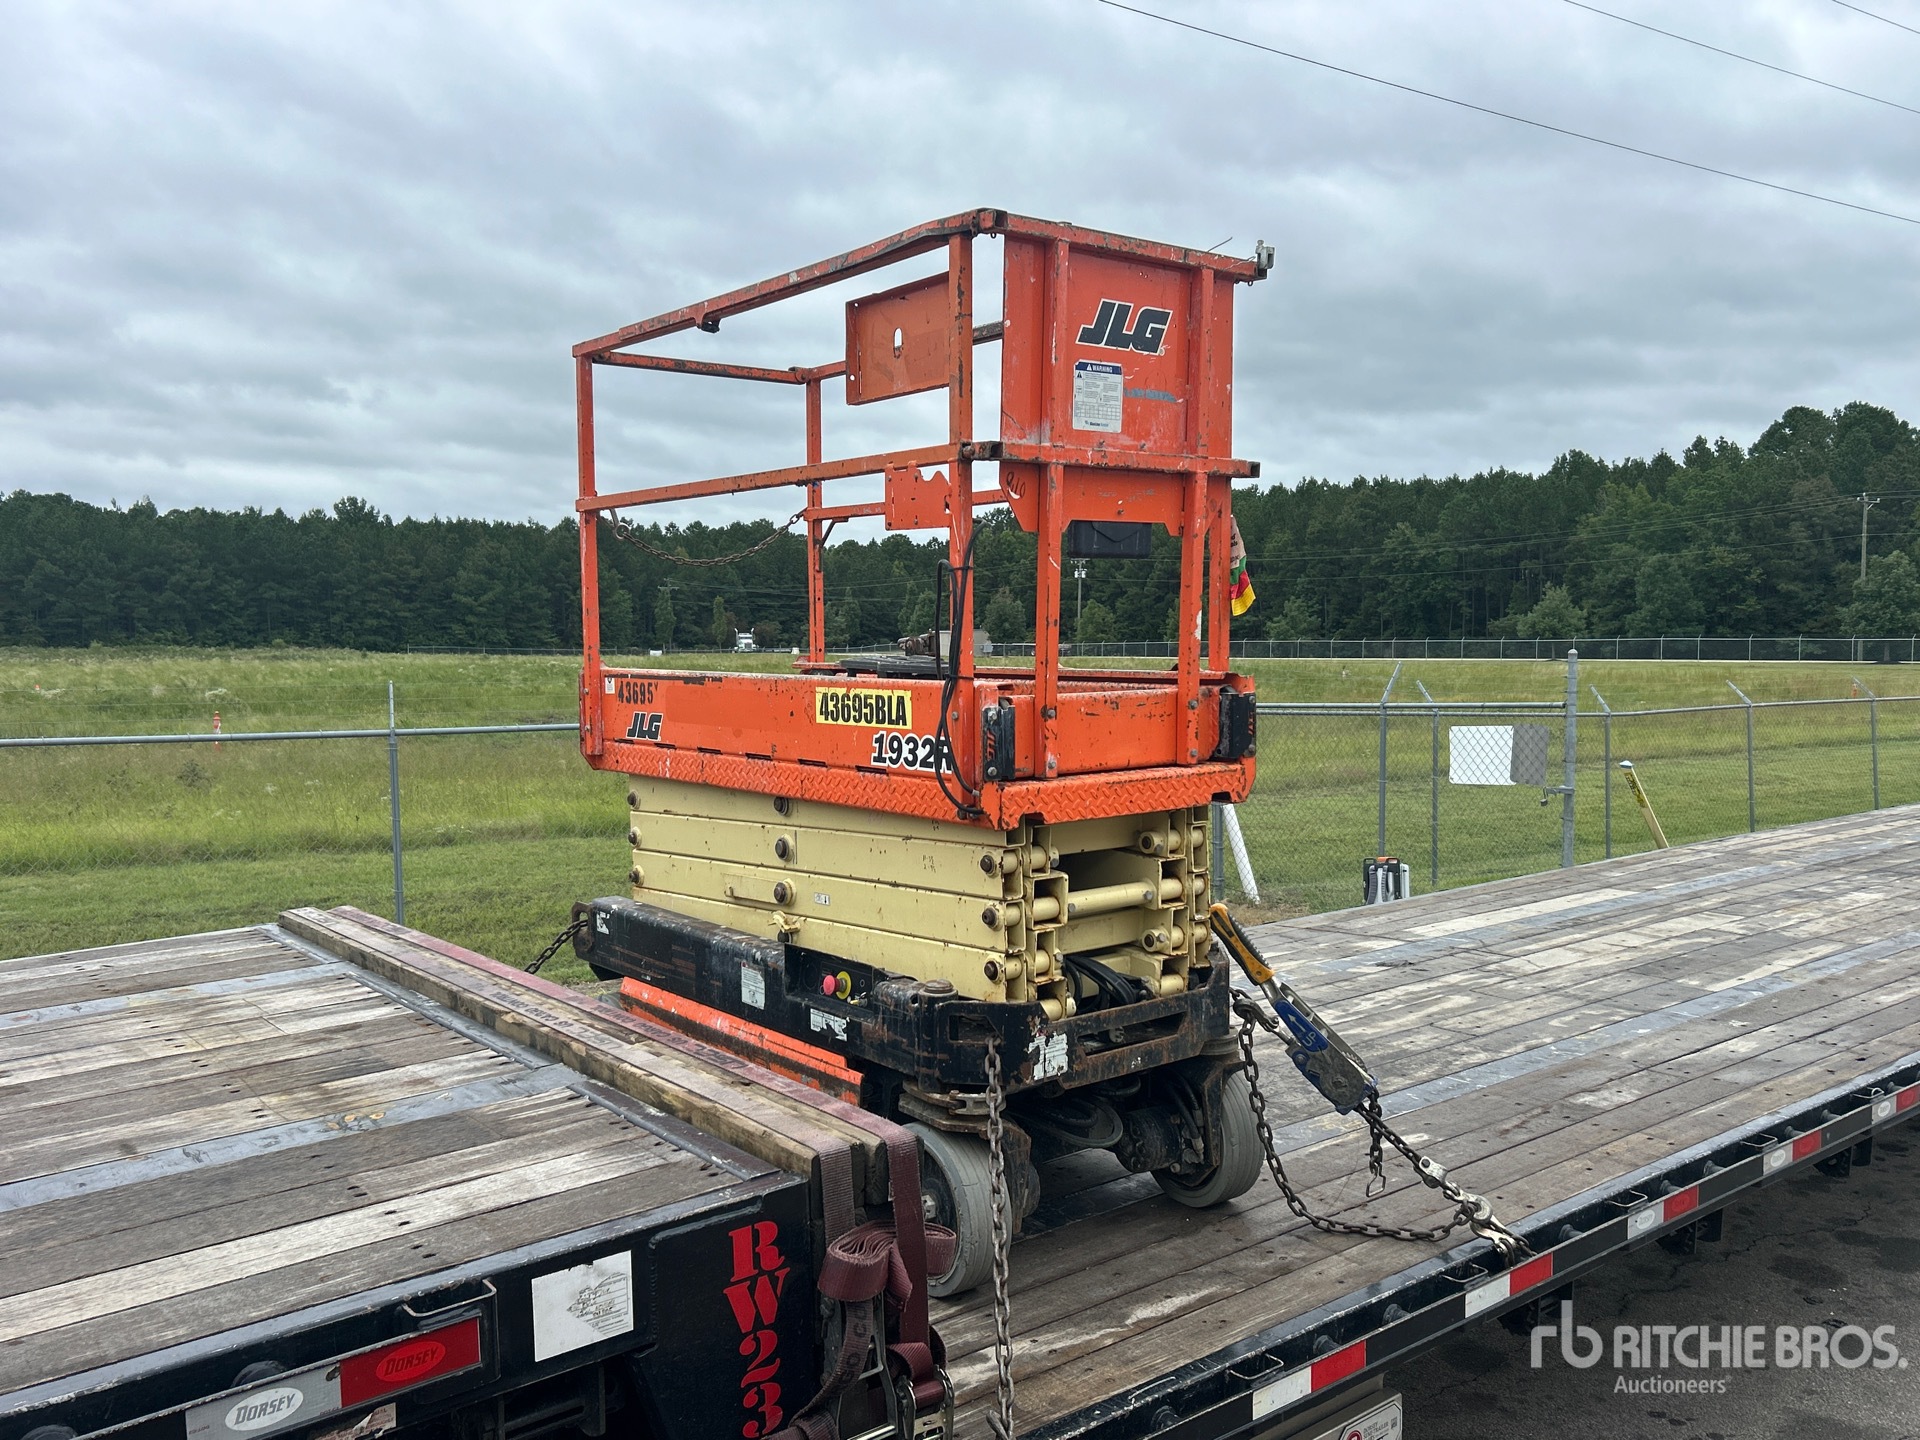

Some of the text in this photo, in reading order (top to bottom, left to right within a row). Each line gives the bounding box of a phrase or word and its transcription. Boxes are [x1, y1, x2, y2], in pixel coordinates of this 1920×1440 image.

[1075, 298, 1173, 355] JLG
[819, 692, 908, 727] 43695BLA
[626, 711, 664, 742] JLG
[1302, 1032, 1316, 1046] UP
[383, 1346, 439, 1377] DORSEY
[233, 1393, 296, 1426] DORSEY
